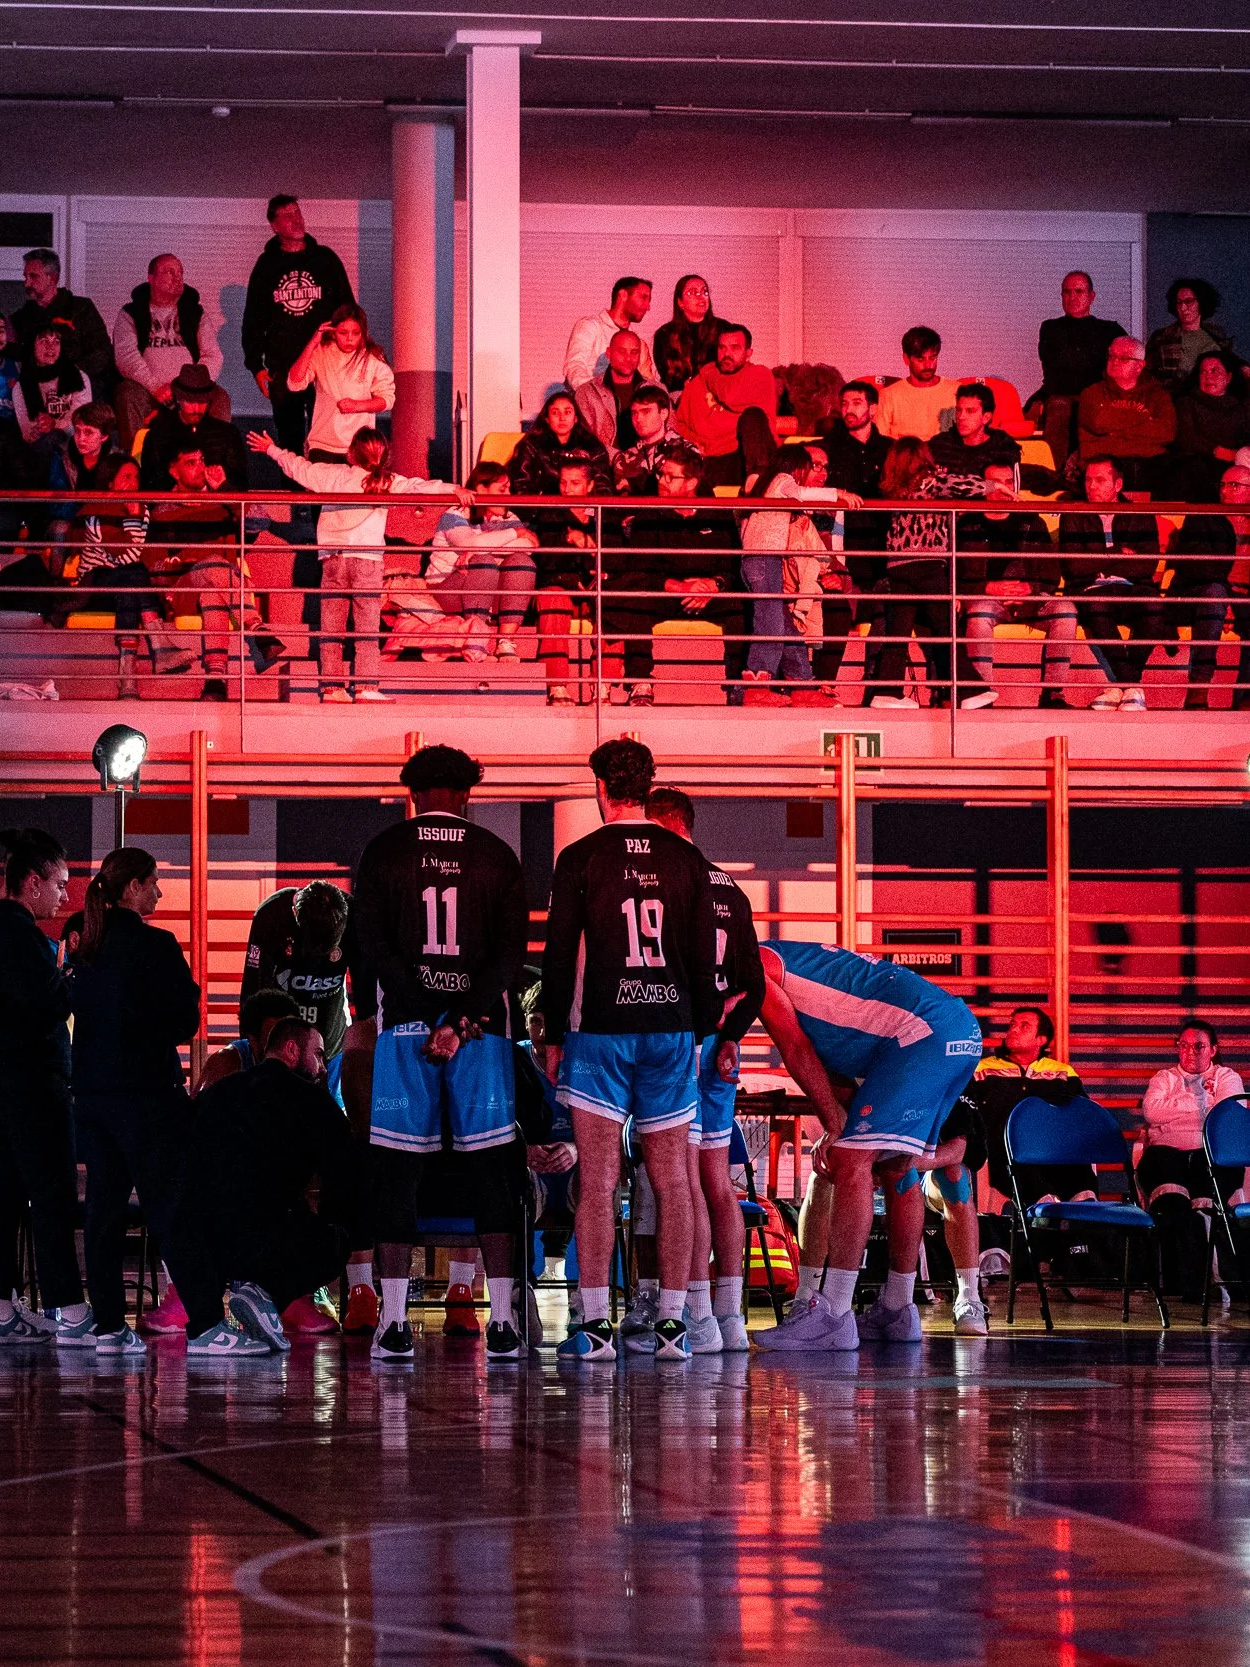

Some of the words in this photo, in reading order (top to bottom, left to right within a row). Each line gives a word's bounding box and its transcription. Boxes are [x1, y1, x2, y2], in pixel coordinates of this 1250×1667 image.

[273, 288, 293, 303] SANT
[293, 285, 322, 301] ANTONI
[417, 826, 467, 842] ISSOUF
[625, 838, 651, 854] PAZ
[421, 885, 461, 956] 11
[621, 897, 667, 968] 19
[891, 953, 952, 965] ARBITROS
[291, 974, 343, 991] Class
[619, 978, 642, 988] Grupo
[616, 984, 680, 1005] MAMBO
